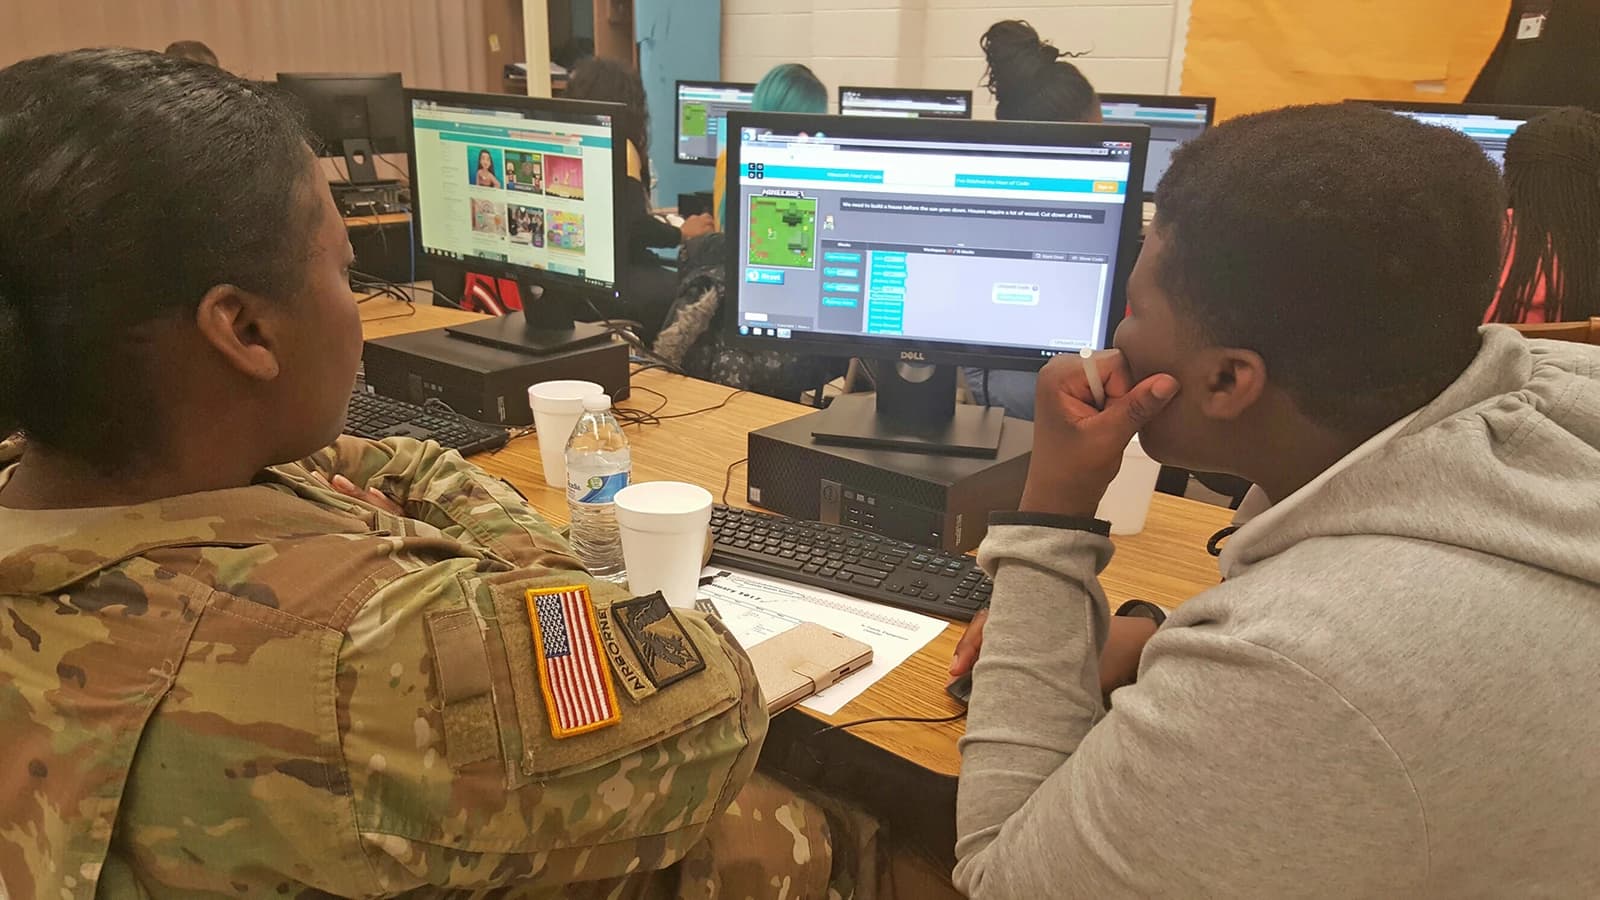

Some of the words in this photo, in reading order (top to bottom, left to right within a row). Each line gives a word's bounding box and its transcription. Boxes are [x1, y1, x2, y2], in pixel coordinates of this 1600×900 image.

[762, 189, 805, 199] MINECRAFT
[901, 351, 925, 361] DELL
[598, 608, 645, 690] AIRBORNE
